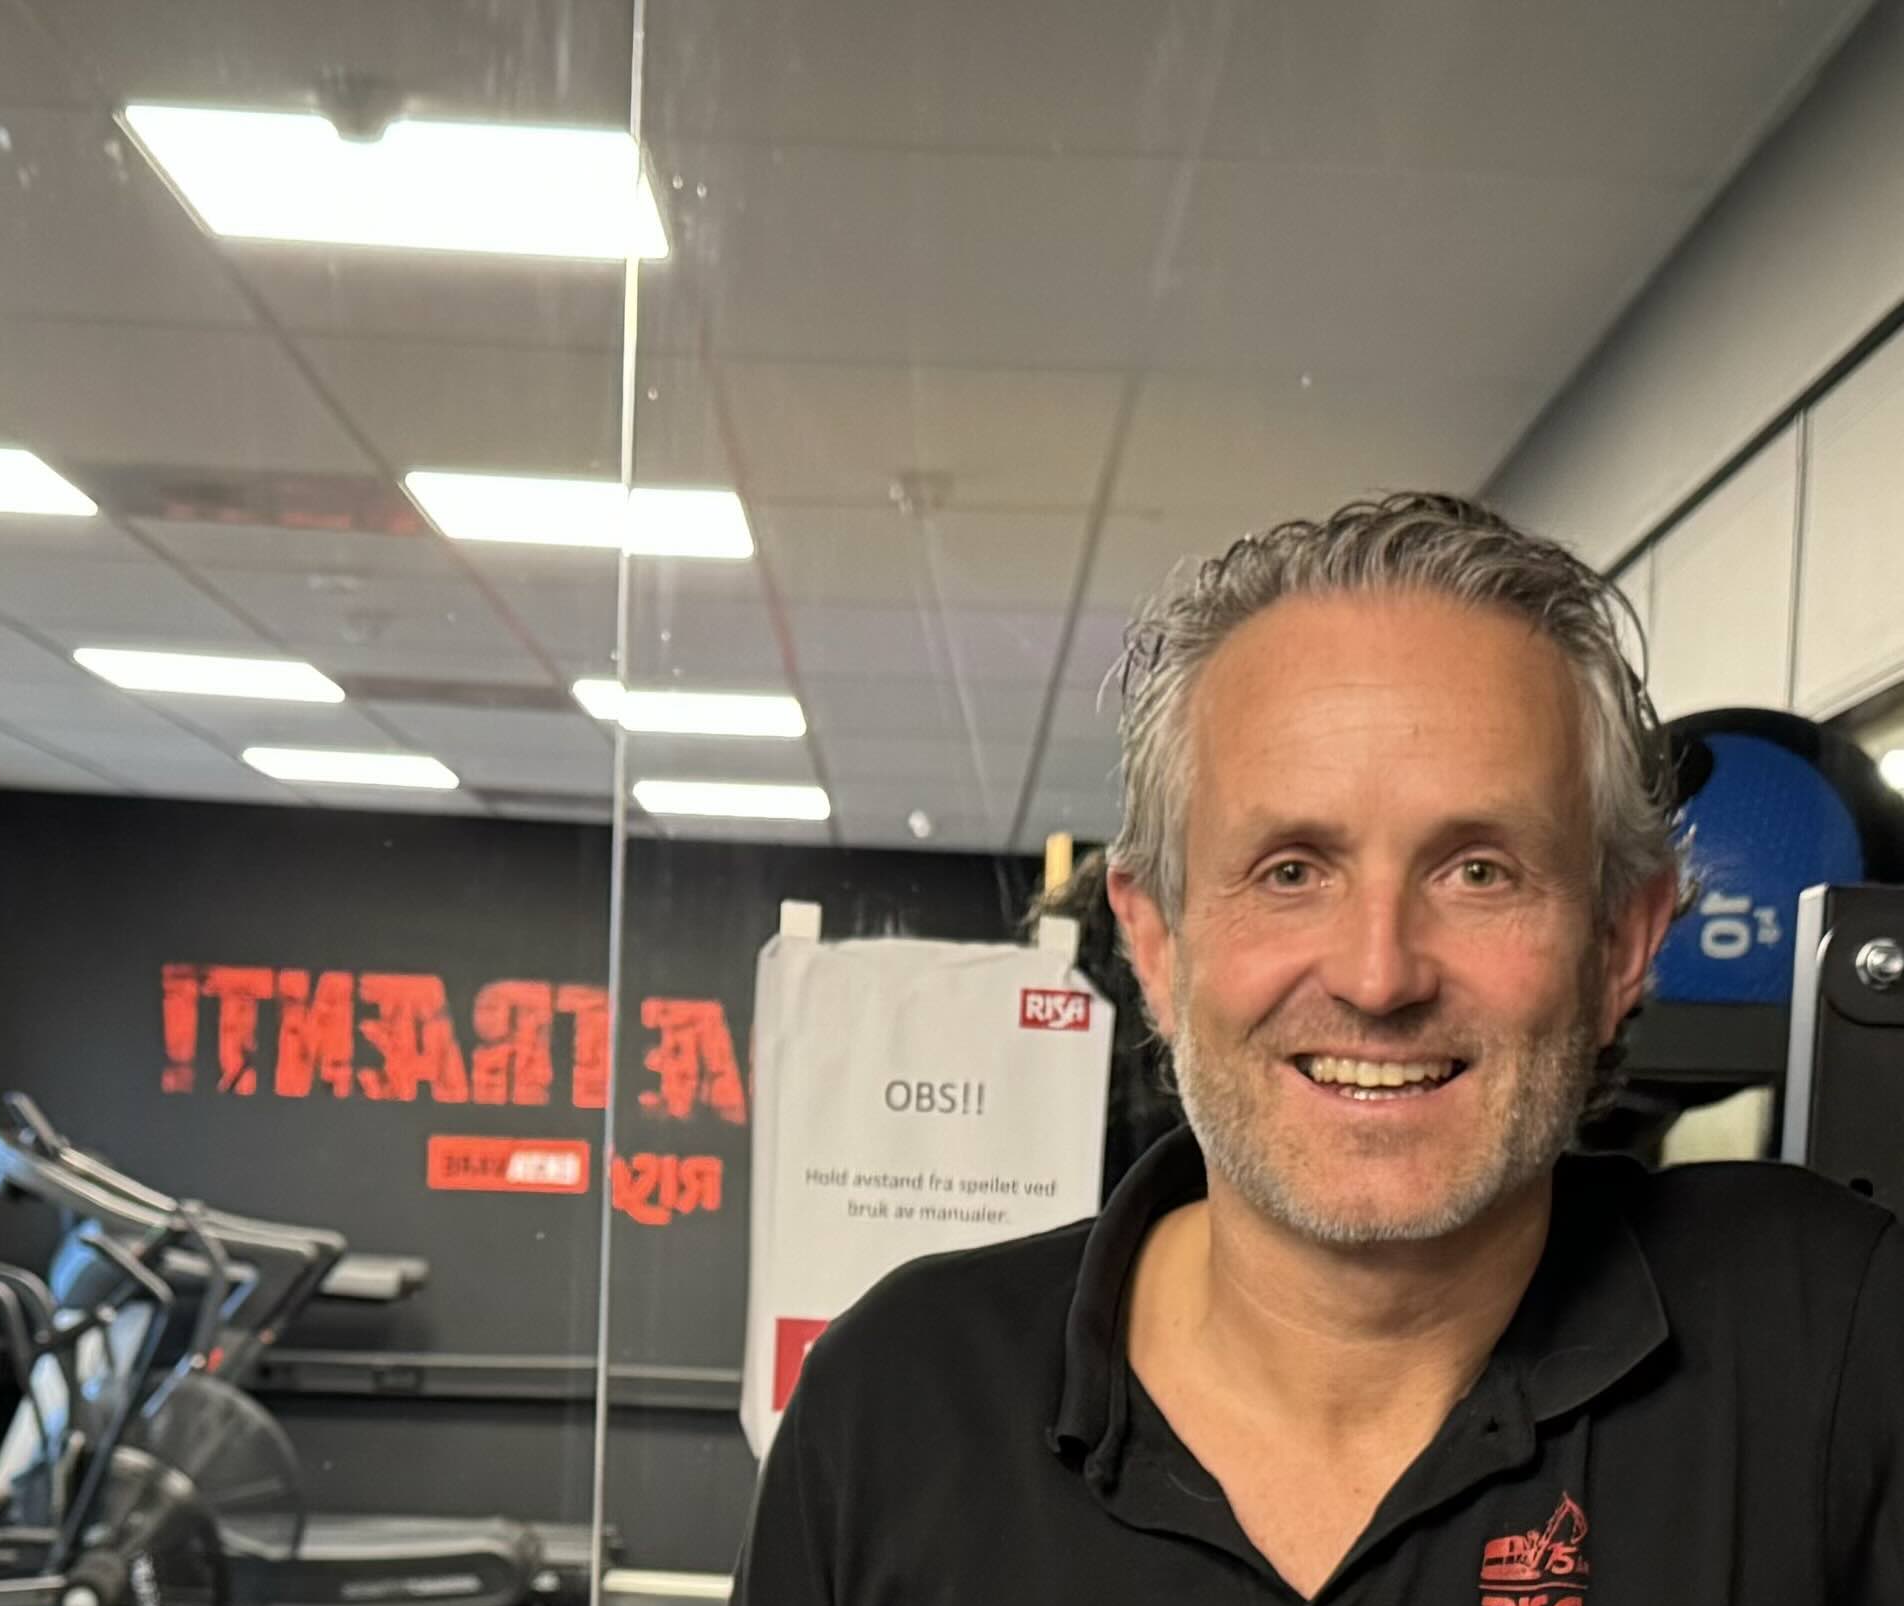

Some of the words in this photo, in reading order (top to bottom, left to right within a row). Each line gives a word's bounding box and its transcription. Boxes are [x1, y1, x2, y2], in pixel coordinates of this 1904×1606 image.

[1025, 992, 1085, 1030] RISA
[885, 1079, 985, 1116] OBS!!
[805, 1168, 847, 1187] Hold
[852, 1170, 923, 1191] avstand
[928, 1172, 954, 1191] fra
[1024, 1180, 1056, 1198] ved
[893, 1205, 914, 1219] av
